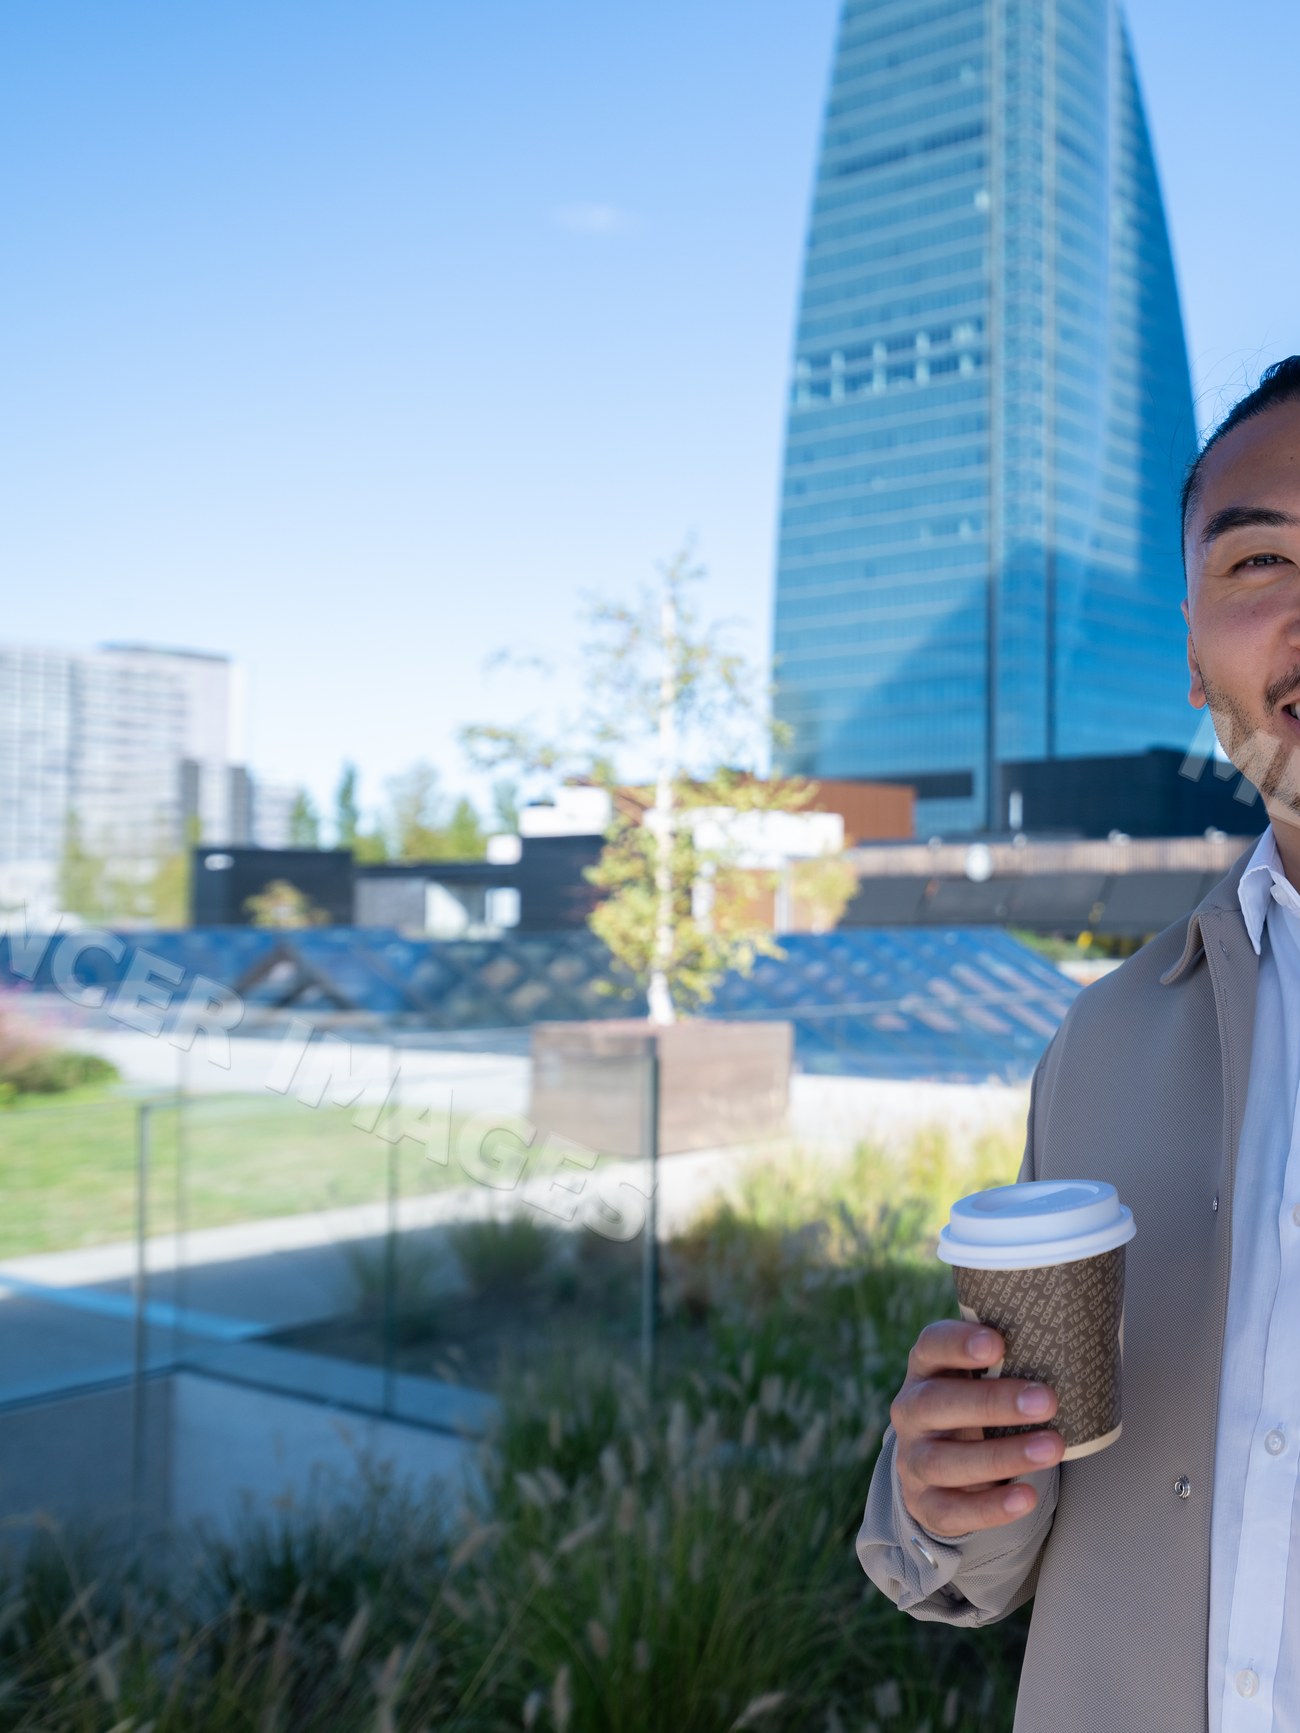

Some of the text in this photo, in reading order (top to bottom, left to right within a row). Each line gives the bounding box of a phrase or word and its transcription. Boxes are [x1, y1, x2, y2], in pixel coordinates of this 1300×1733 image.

[1077, 1267, 1093, 1282] TEA
[991, 1278, 1005, 1294] TEA
[1000, 1271, 1022, 1304] COFFEE
[1071, 1270, 1102, 1299] COFFEE
[1087, 1283, 1103, 1299] TEA
[1009, 1292, 1024, 1309] TEA
[1014, 1288, 1038, 1324] COFFEE
[1069, 1309, 1087, 1325] TEA
[1011, 1321, 1034, 1355] COFFEE
[1031, 1299, 1046, 1317] TEA
[1027, 1329, 1043, 1347] TEA
[1068, 1334, 1086, 1350] TEA
[1030, 1332, 1054, 1369] COFFEE
[1043, 1348, 1058, 1366] TEA
[1068, 1333, 1101, 1363] COFFEE
[1086, 1345, 1102, 1361] TEA
[1075, 1351, 1105, 1383] COFFEE
[1086, 1370, 1102, 1387] TEA
[1066, 1398, 1083, 1414] TEA
[1086, 1367, 1113, 1399] COFFEE
[1073, 1416, 1090, 1434] TEA
